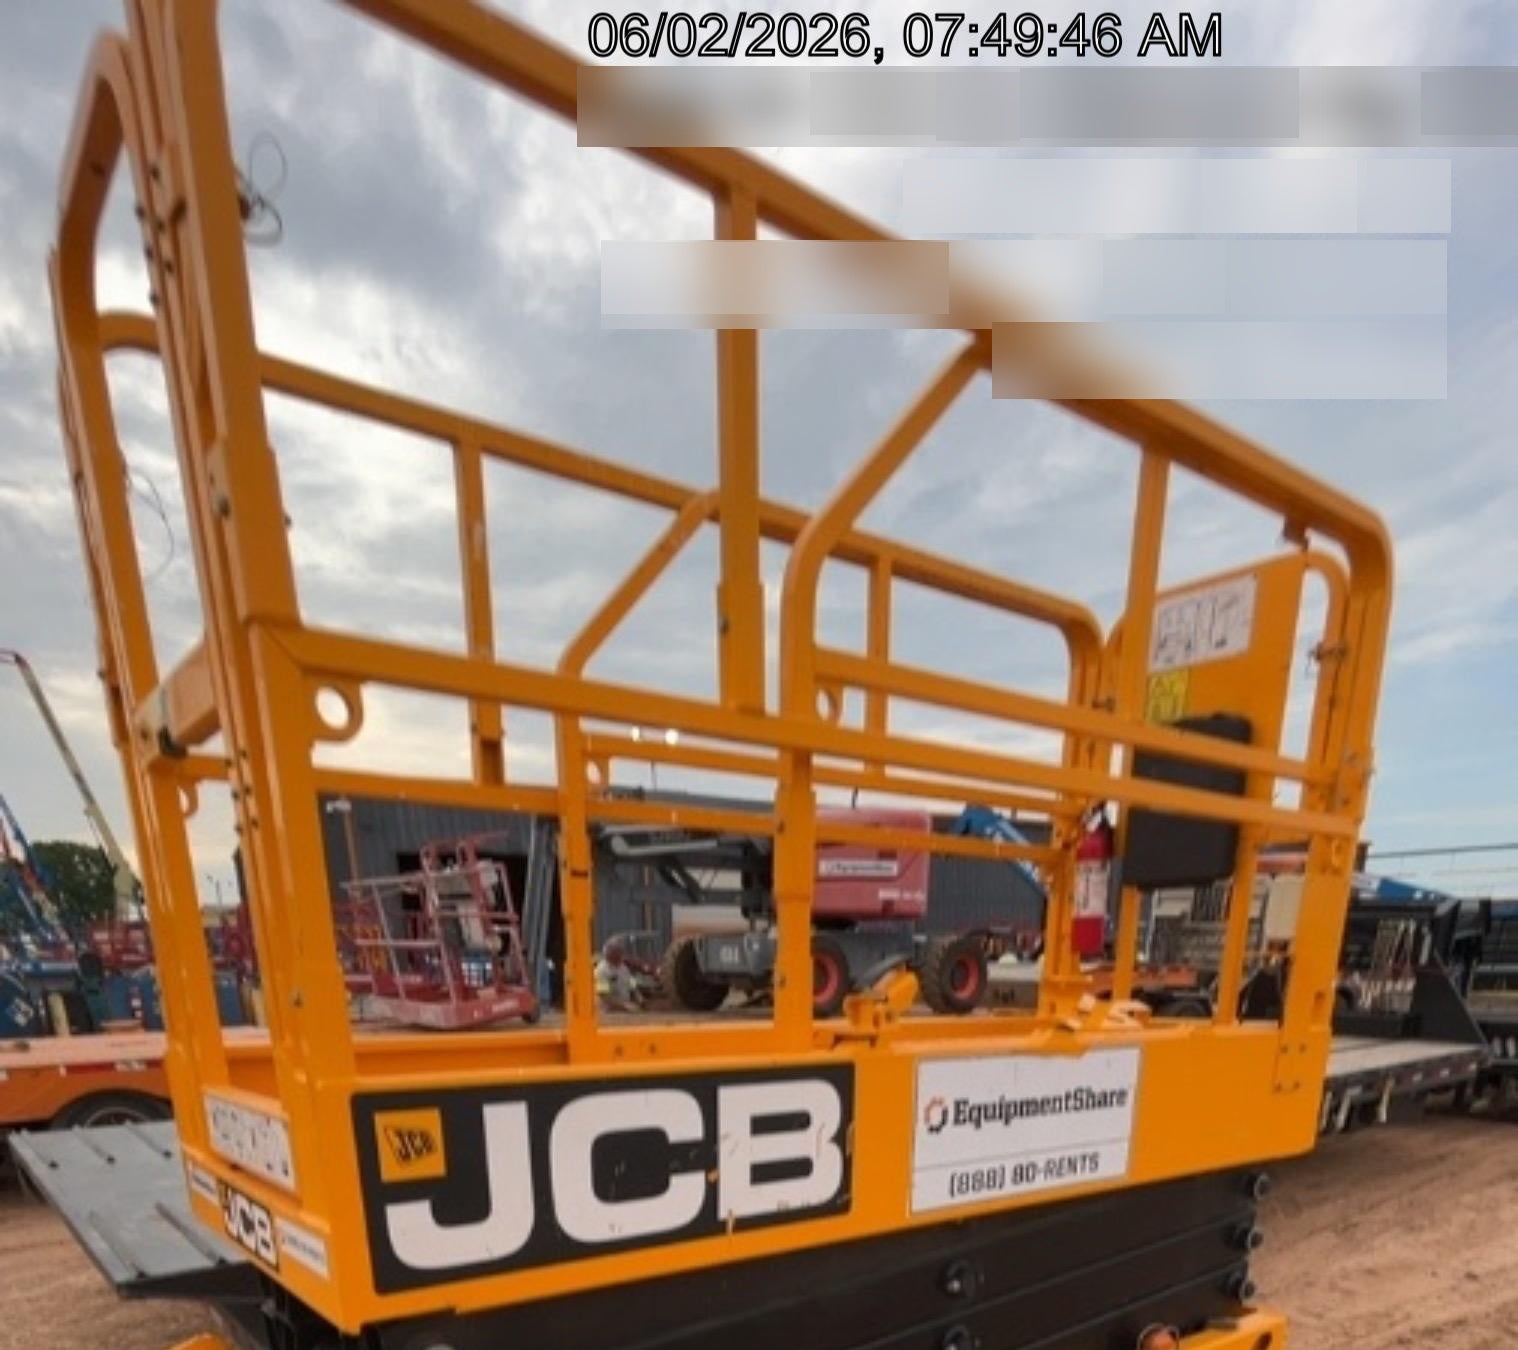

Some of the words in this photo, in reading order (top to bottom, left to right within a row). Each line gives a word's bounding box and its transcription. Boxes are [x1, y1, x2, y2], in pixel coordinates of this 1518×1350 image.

[951, 1086, 1127, 1129] EquipmentShare
[392, 1127, 437, 1164] JCB
[385, 1079, 845, 1270] JCB
[949, 1167, 1005, 1198] (888)
[1011, 1153, 1100, 1186] 80-RENTS
[224, 1188, 277, 1267] JCB
